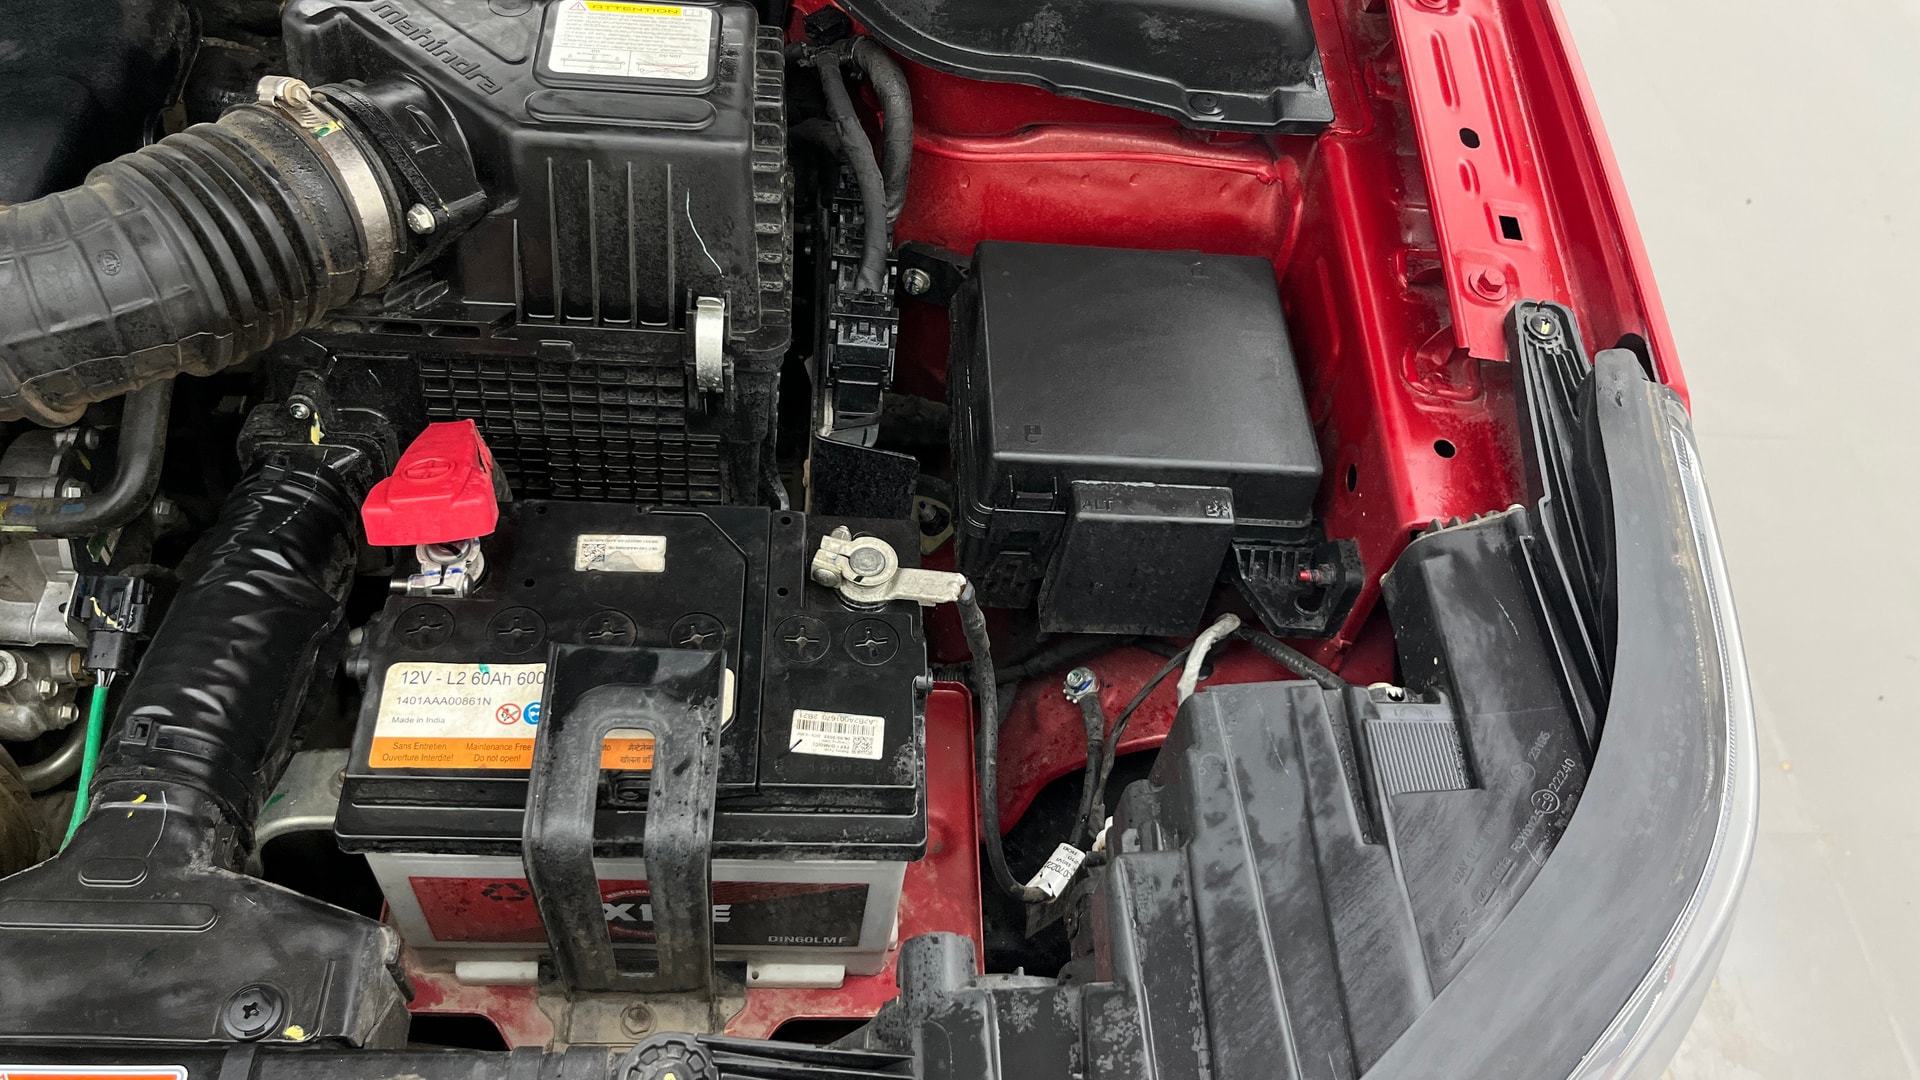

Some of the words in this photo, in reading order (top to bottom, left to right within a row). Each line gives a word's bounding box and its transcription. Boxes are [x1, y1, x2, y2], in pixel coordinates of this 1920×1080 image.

[592, 3, 679, 14] ATTENTION
[401, 670, 432, 685] 12V
[447, 671, 465, 685] L2
[471, 671, 512, 686] 60Ah
[517, 671, 545, 686] 600
[396, 696, 491, 706] 1401AAA00861N
[392, 716, 414, 724] Made
[416, 716, 423, 724] in
[425, 716, 446, 724] India
[393, 742, 411, 750] Sans
[414, 742, 447, 750] Entretien
[466, 743, 513, 751] Maintenance
[515, 743, 532, 751] Free
[382, 753, 419, 762] Ouverture
[421, 753, 454, 762] Interdite!
[474, 754, 484, 762] Do
[500, 754, 521, 763] open!
[767, 934, 848, 945] DIN60LMF
